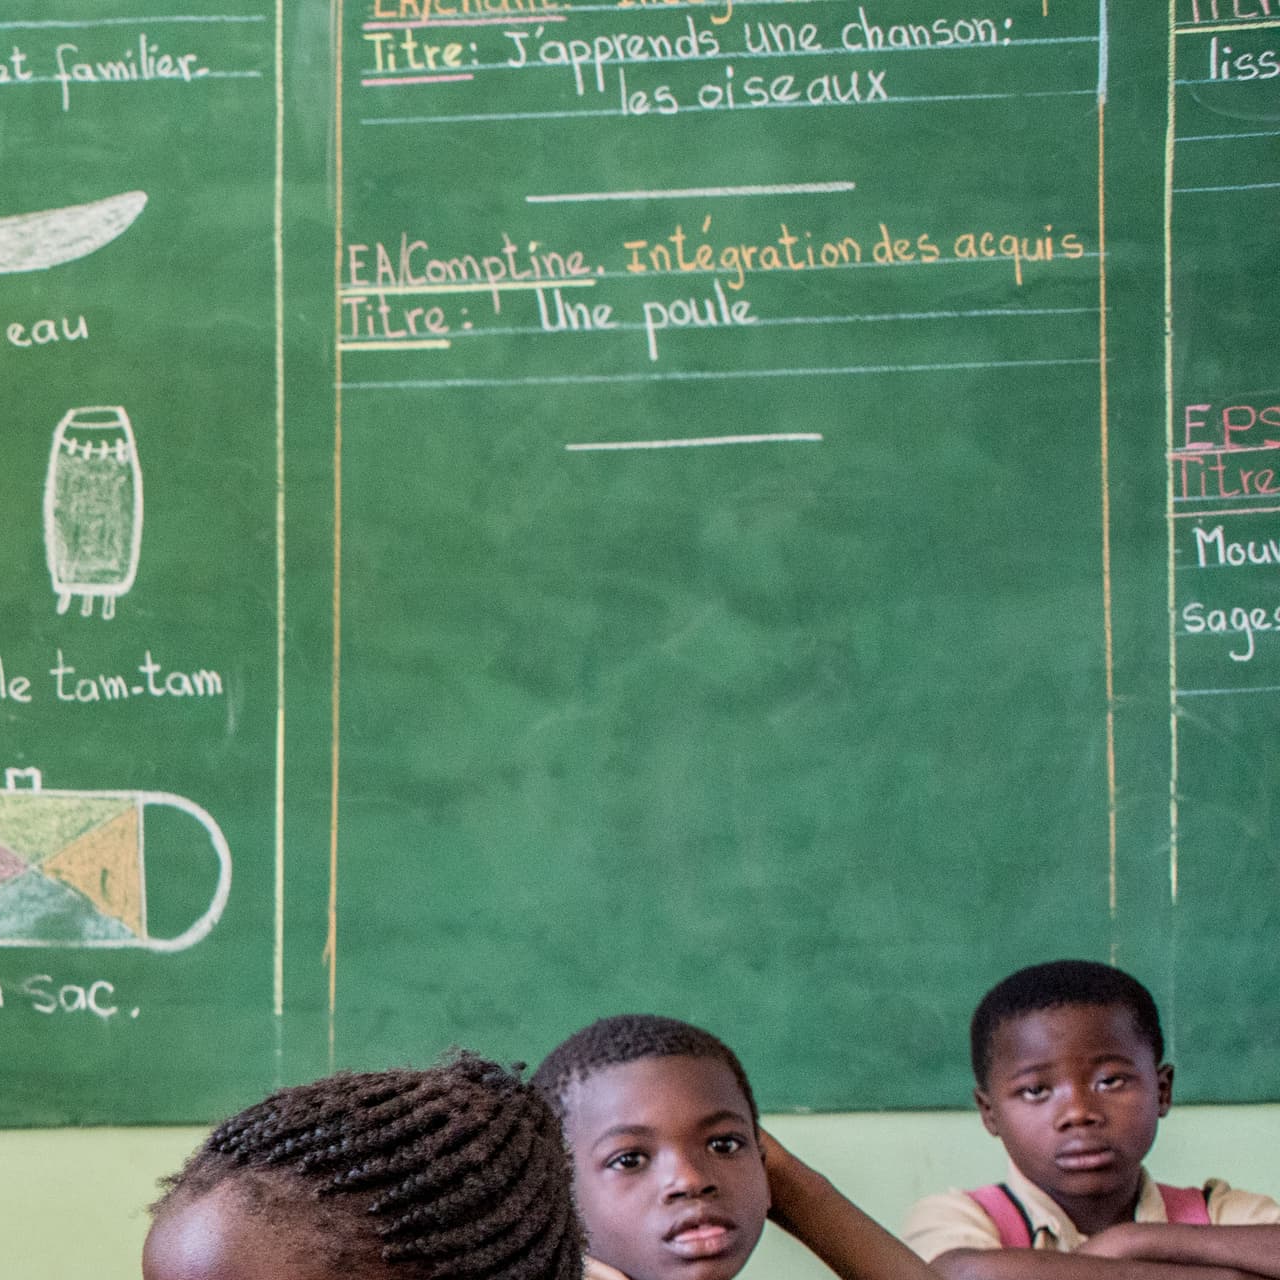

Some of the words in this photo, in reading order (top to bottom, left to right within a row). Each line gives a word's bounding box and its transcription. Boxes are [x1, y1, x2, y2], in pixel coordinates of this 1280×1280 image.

[503, 16, 720, 95] J'apprends
[744, 22, 822, 52] une
[619, 68, 678, 115] les
[698, 66, 889, 109] oiseaux
[623, 215, 862, 290] Intégration
[872, 223, 941, 264] des
[953, 224, 1085, 286] acquis
[537, 287, 618, 331] Une
[643, 278, 760, 361] poule
[49, 648, 224, 702] tam-tam
